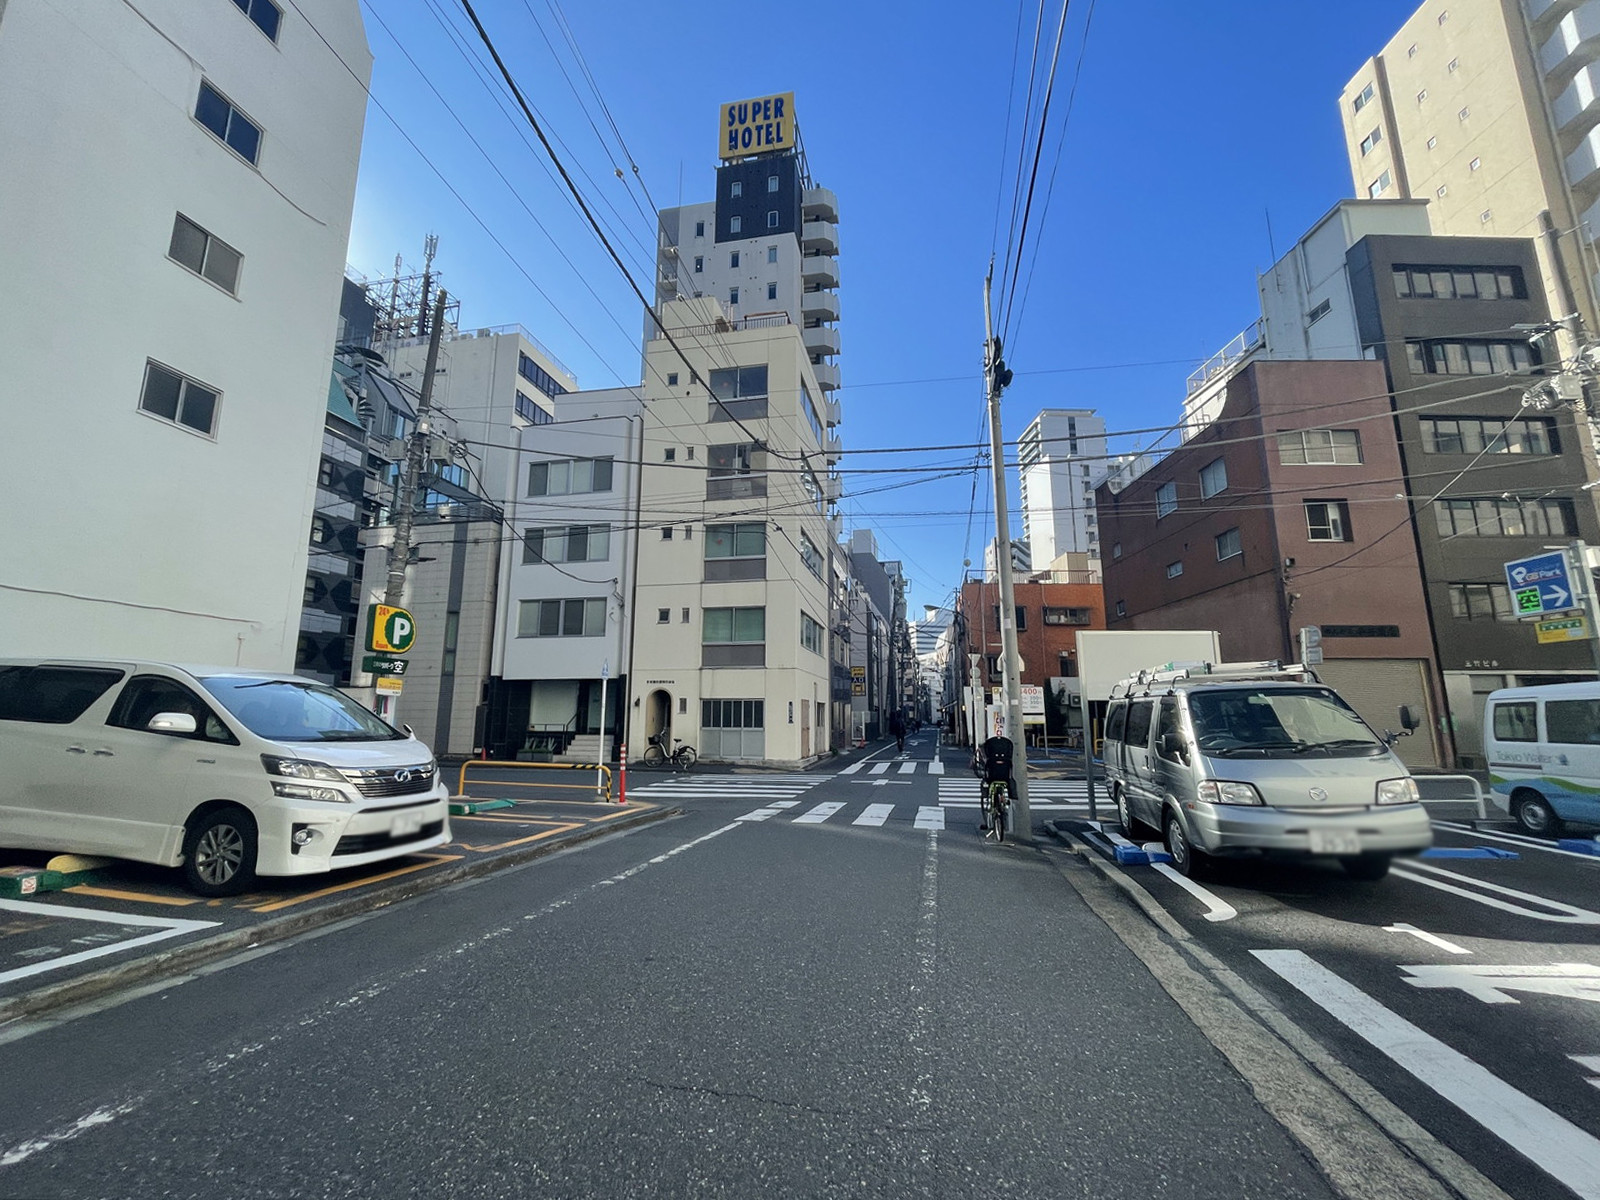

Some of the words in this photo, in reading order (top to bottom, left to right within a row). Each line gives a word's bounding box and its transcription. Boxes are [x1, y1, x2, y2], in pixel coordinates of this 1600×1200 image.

[728, 97, 784, 127] SUPER
[728, 121, 784, 151] HOTEL
[392, 616, 410, 645] P
[393, 660, 404, 674] 空
